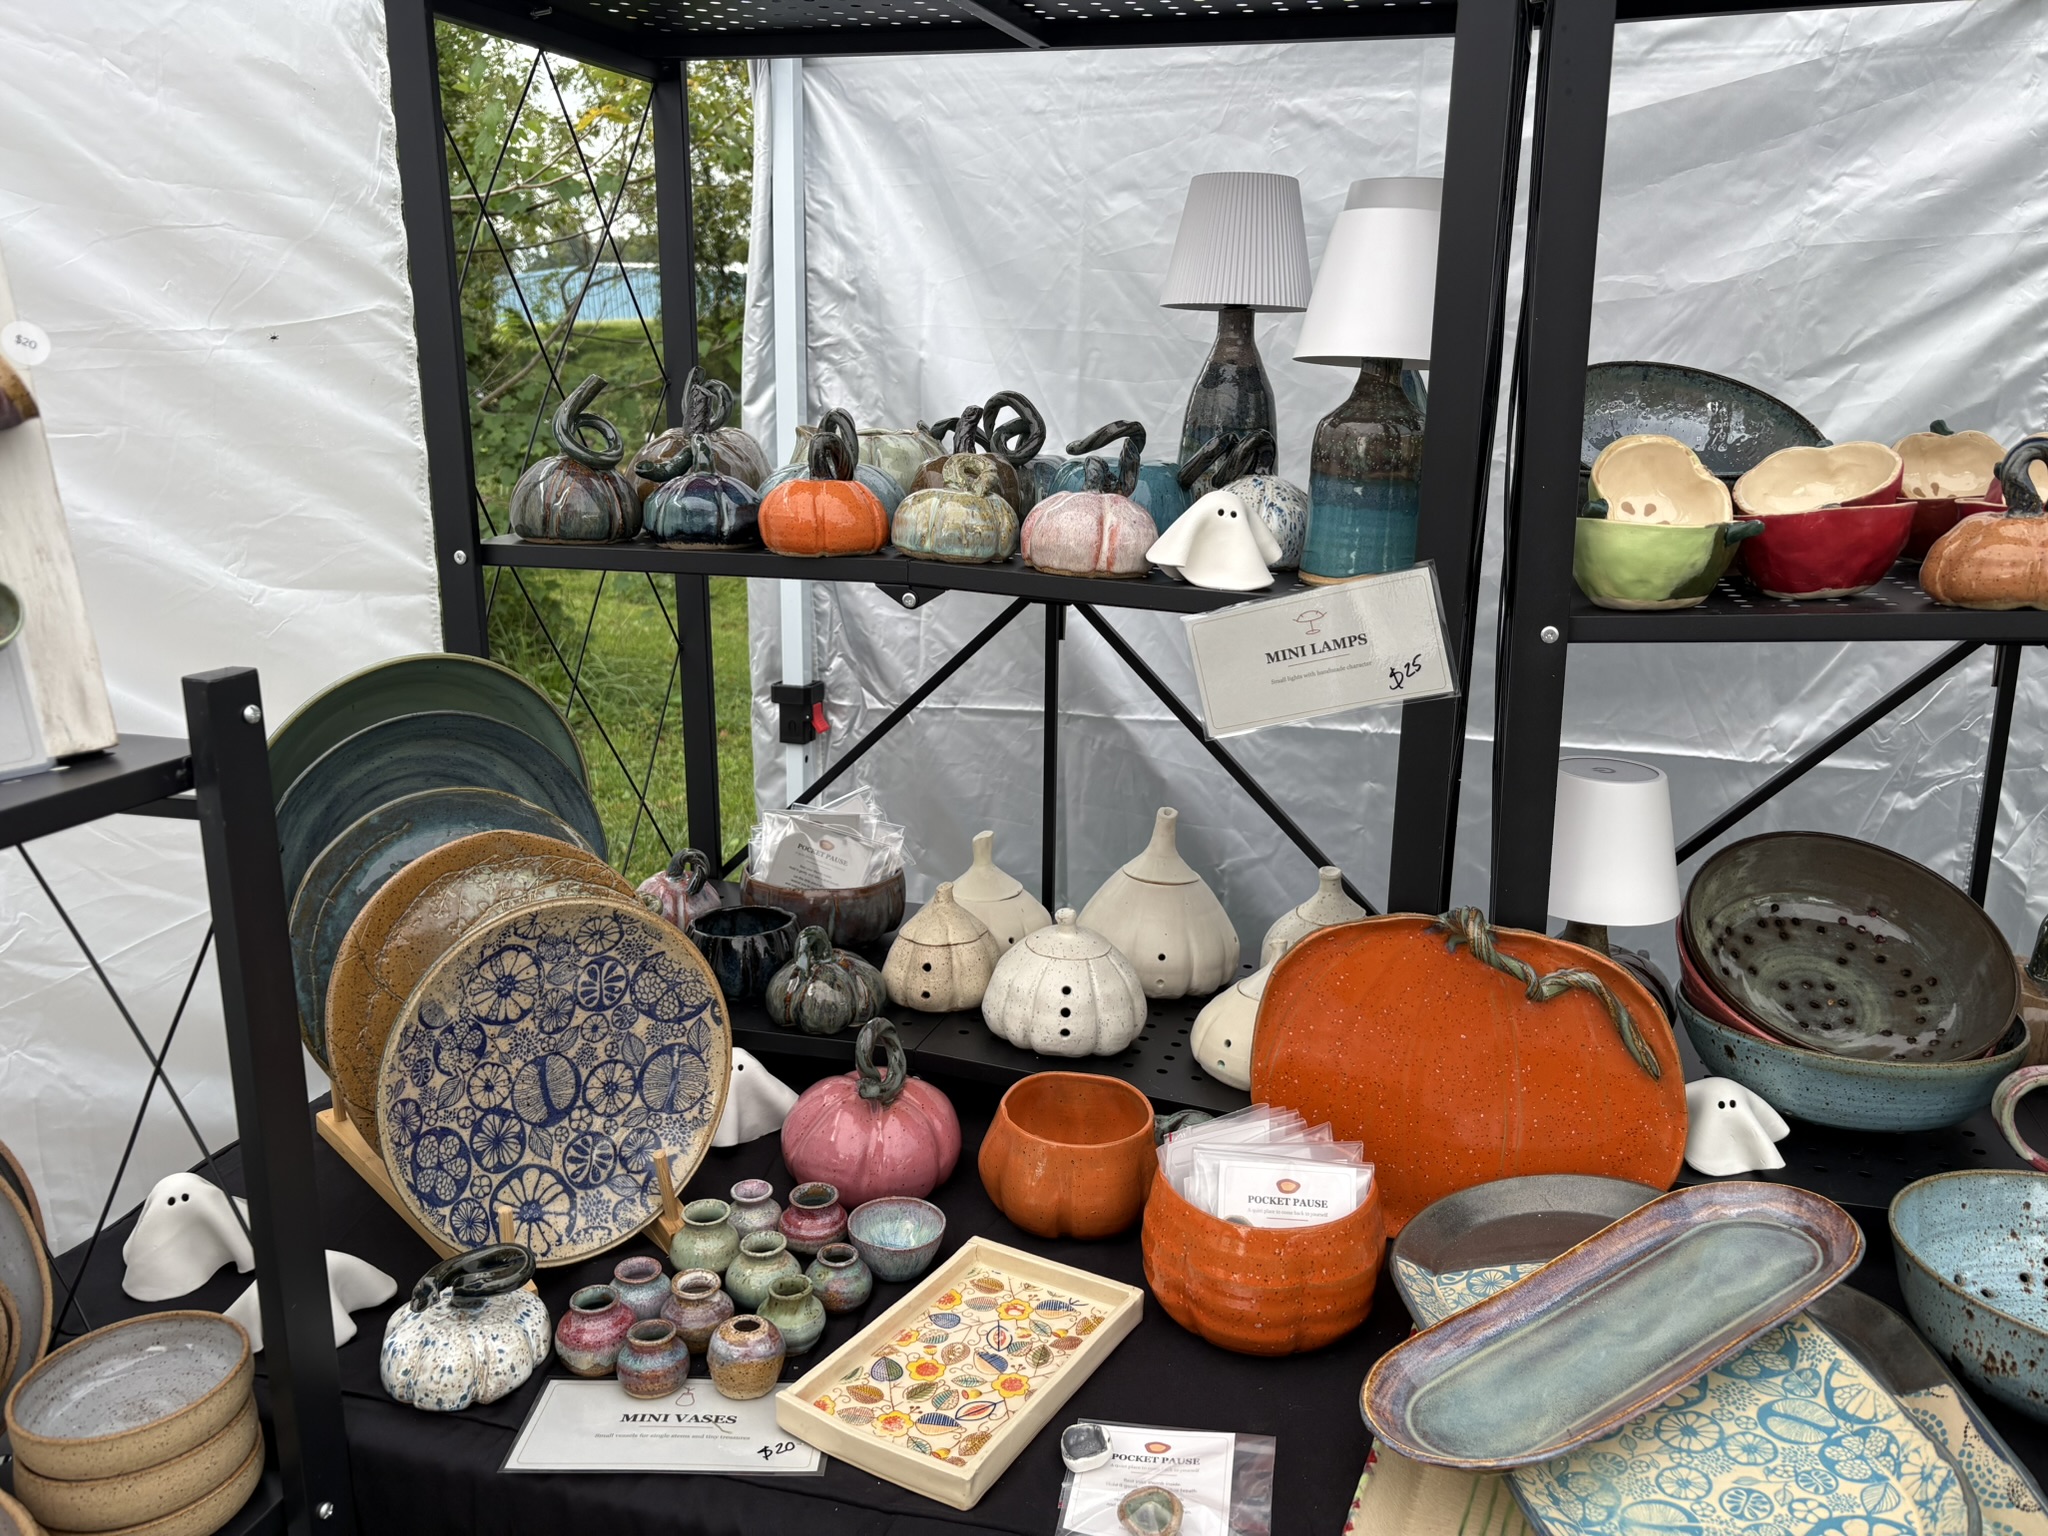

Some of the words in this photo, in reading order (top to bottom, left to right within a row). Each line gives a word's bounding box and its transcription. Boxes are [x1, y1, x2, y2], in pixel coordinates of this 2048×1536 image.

[15, 334, 38, 350] $20
[1265, 645, 1307, 664] MINI
[1309, 633, 1368, 655] LAMPS
[1271, 675, 1287, 685] Small
[1287, 672, 1303, 684] lights
[1303, 670, 1316, 679] with
[1316, 665, 1346, 676] handmade
[1346, 660, 1373, 671] character
[1389, 654, 1422, 690] $25
[797, 843, 825, 858] POCKET
[825, 852, 849, 867] PAUSE
[1247, 1195, 1291, 1206] POCKET
[1292, 1198, 1329, 1208] PAUSE
[621, 1413, 670, 1423] MINI
[675, 1414, 738, 1424] VASES
[757, 1441, 795, 1460] $20
[1112, 1453, 1160, 1463] POCKET
[1161, 1457, 1200, 1466] PAUSE
